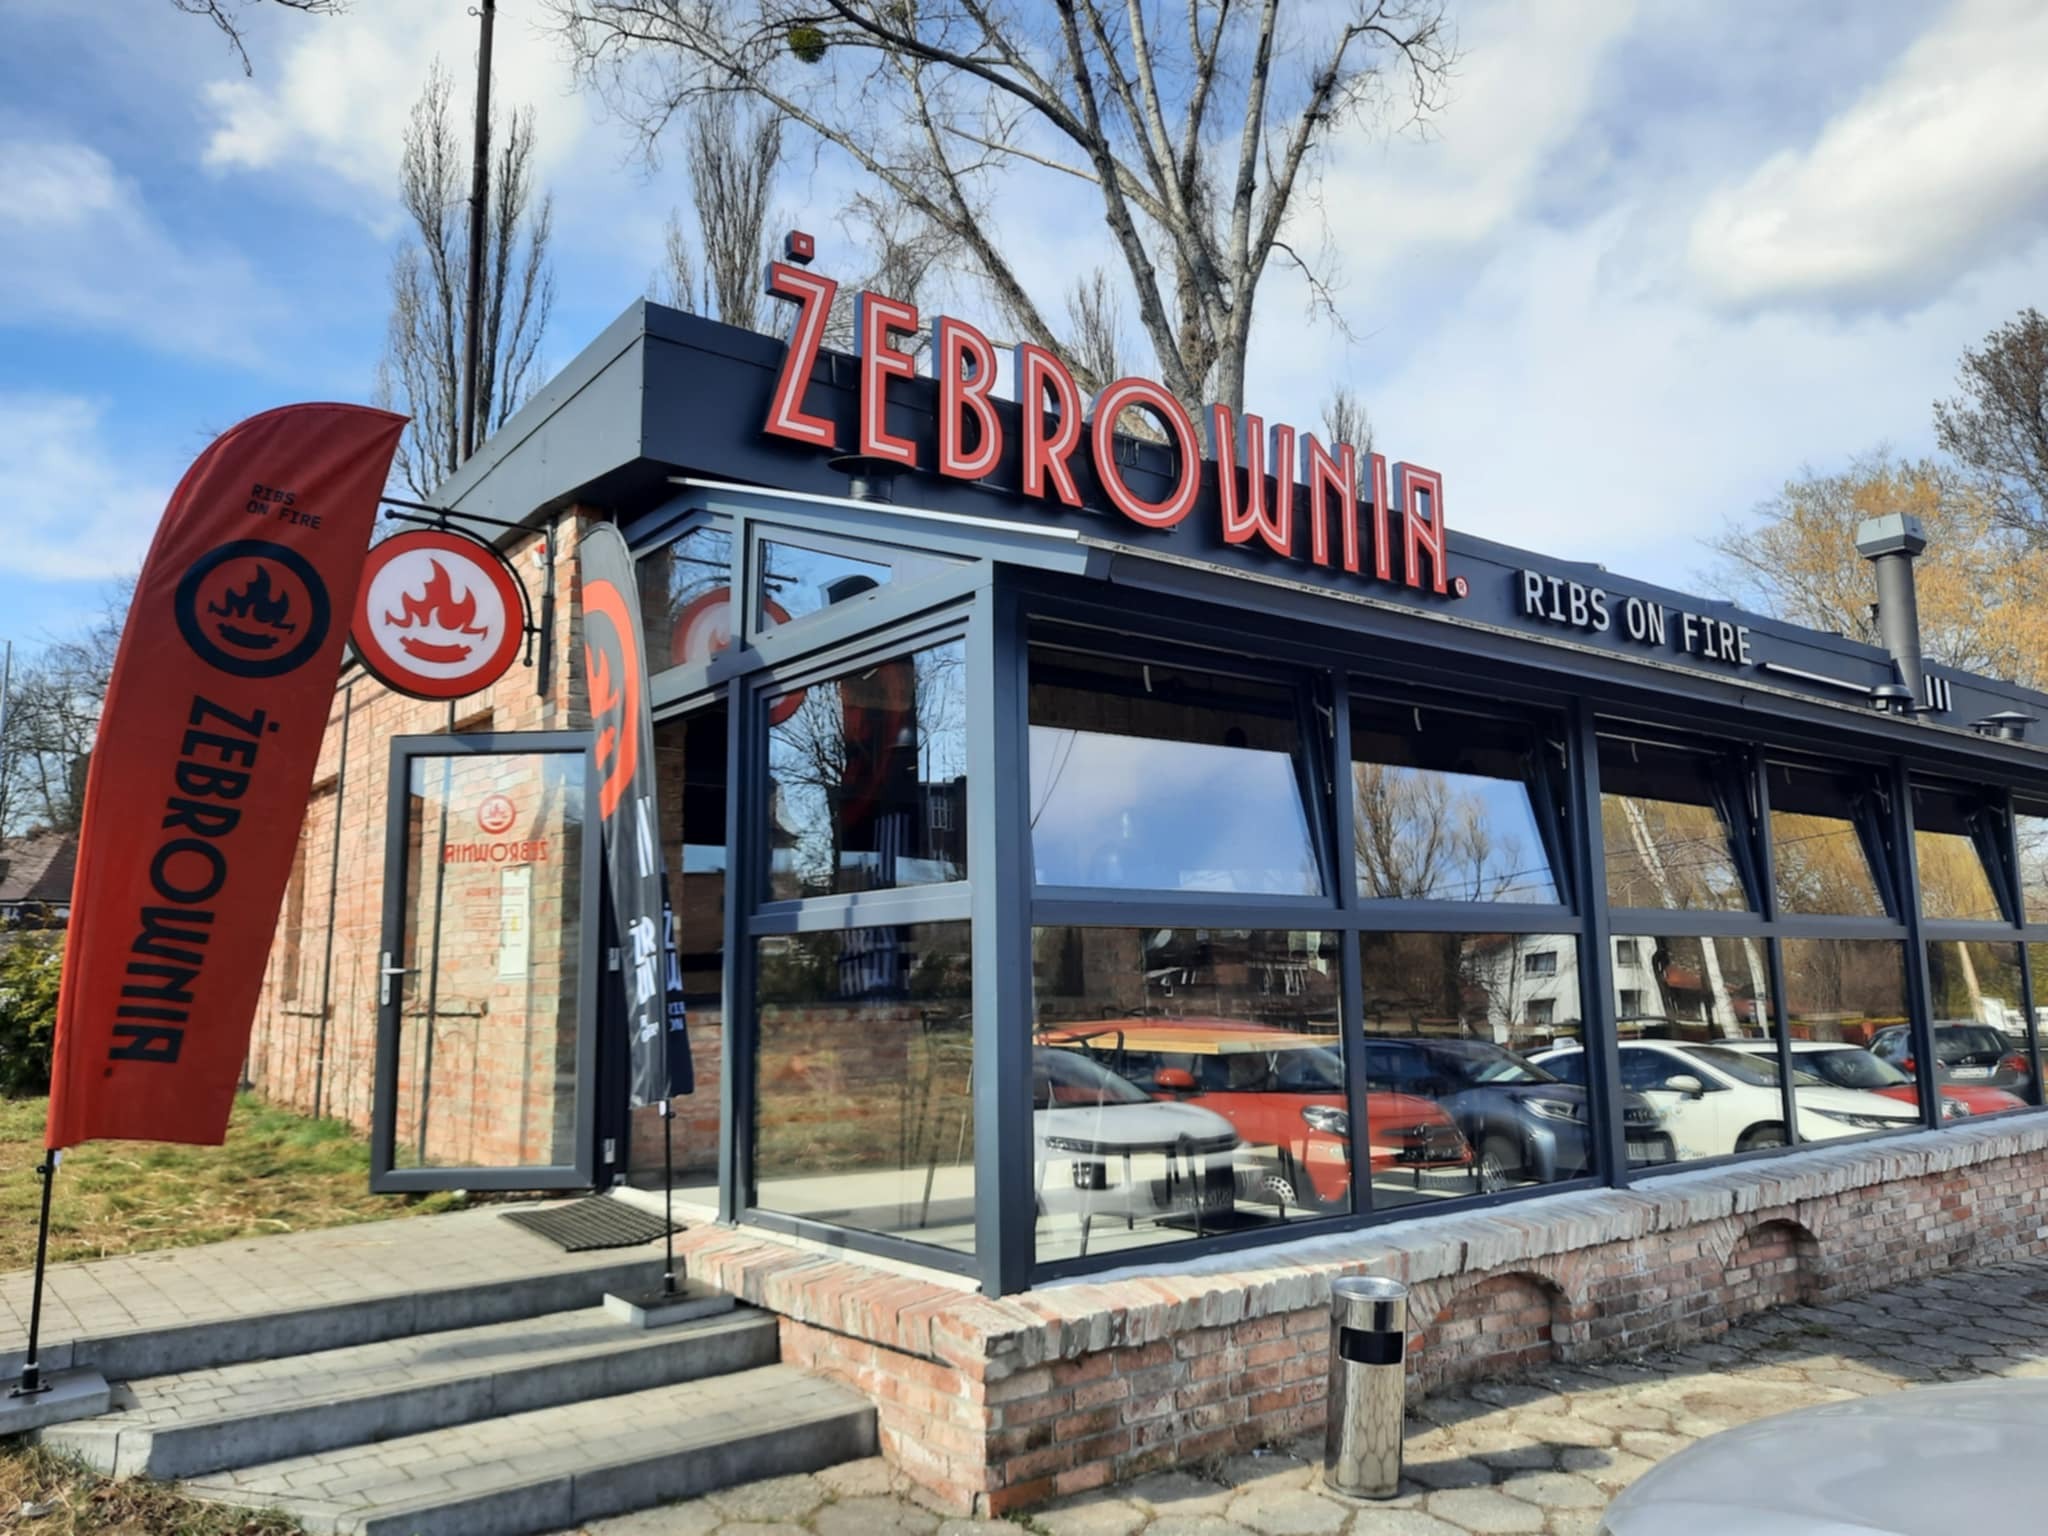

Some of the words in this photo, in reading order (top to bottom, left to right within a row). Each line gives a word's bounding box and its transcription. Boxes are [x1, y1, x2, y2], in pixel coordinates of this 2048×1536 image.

[252, 484, 296, 505] RIBS
[246, 500, 269, 515] ON
[279, 508, 321, 530] FIRE
[1522, 569, 1610, 631] RIBS
[1625, 597, 1666, 645] ON
[1681, 612, 1754, 665] FIRE
